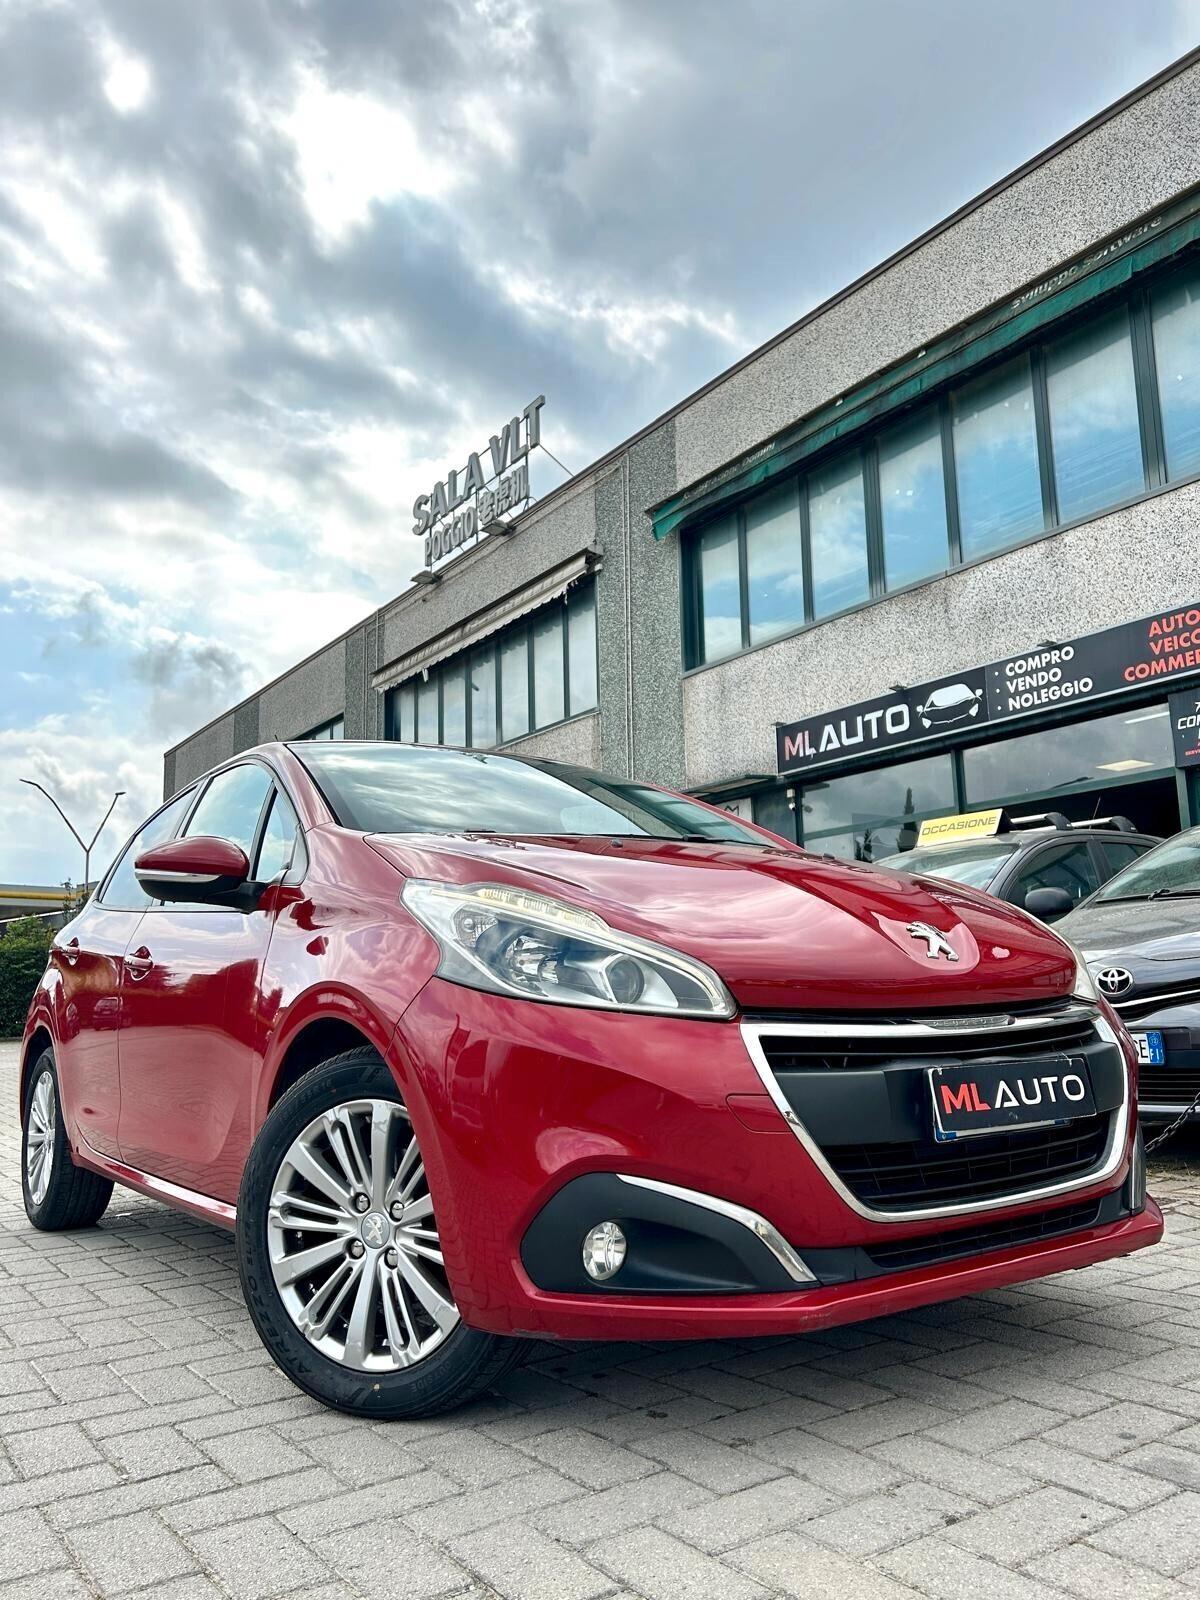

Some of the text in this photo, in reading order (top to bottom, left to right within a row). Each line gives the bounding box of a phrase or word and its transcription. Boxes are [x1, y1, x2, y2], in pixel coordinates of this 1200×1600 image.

[412, 394, 546, 536] SALA VLT
[425, 506, 478, 566] POGGIO
[1005, 645, 1074, 677] COMPRO
[1006, 667, 1062, 694] VENDO
[1008, 677, 1093, 711] NOLEGGIO
[819, 703, 910, 752] AUTO
[921, 816, 997, 836] OCCASIONE
[940, 1074, 1085, 1114] ML AUTO
